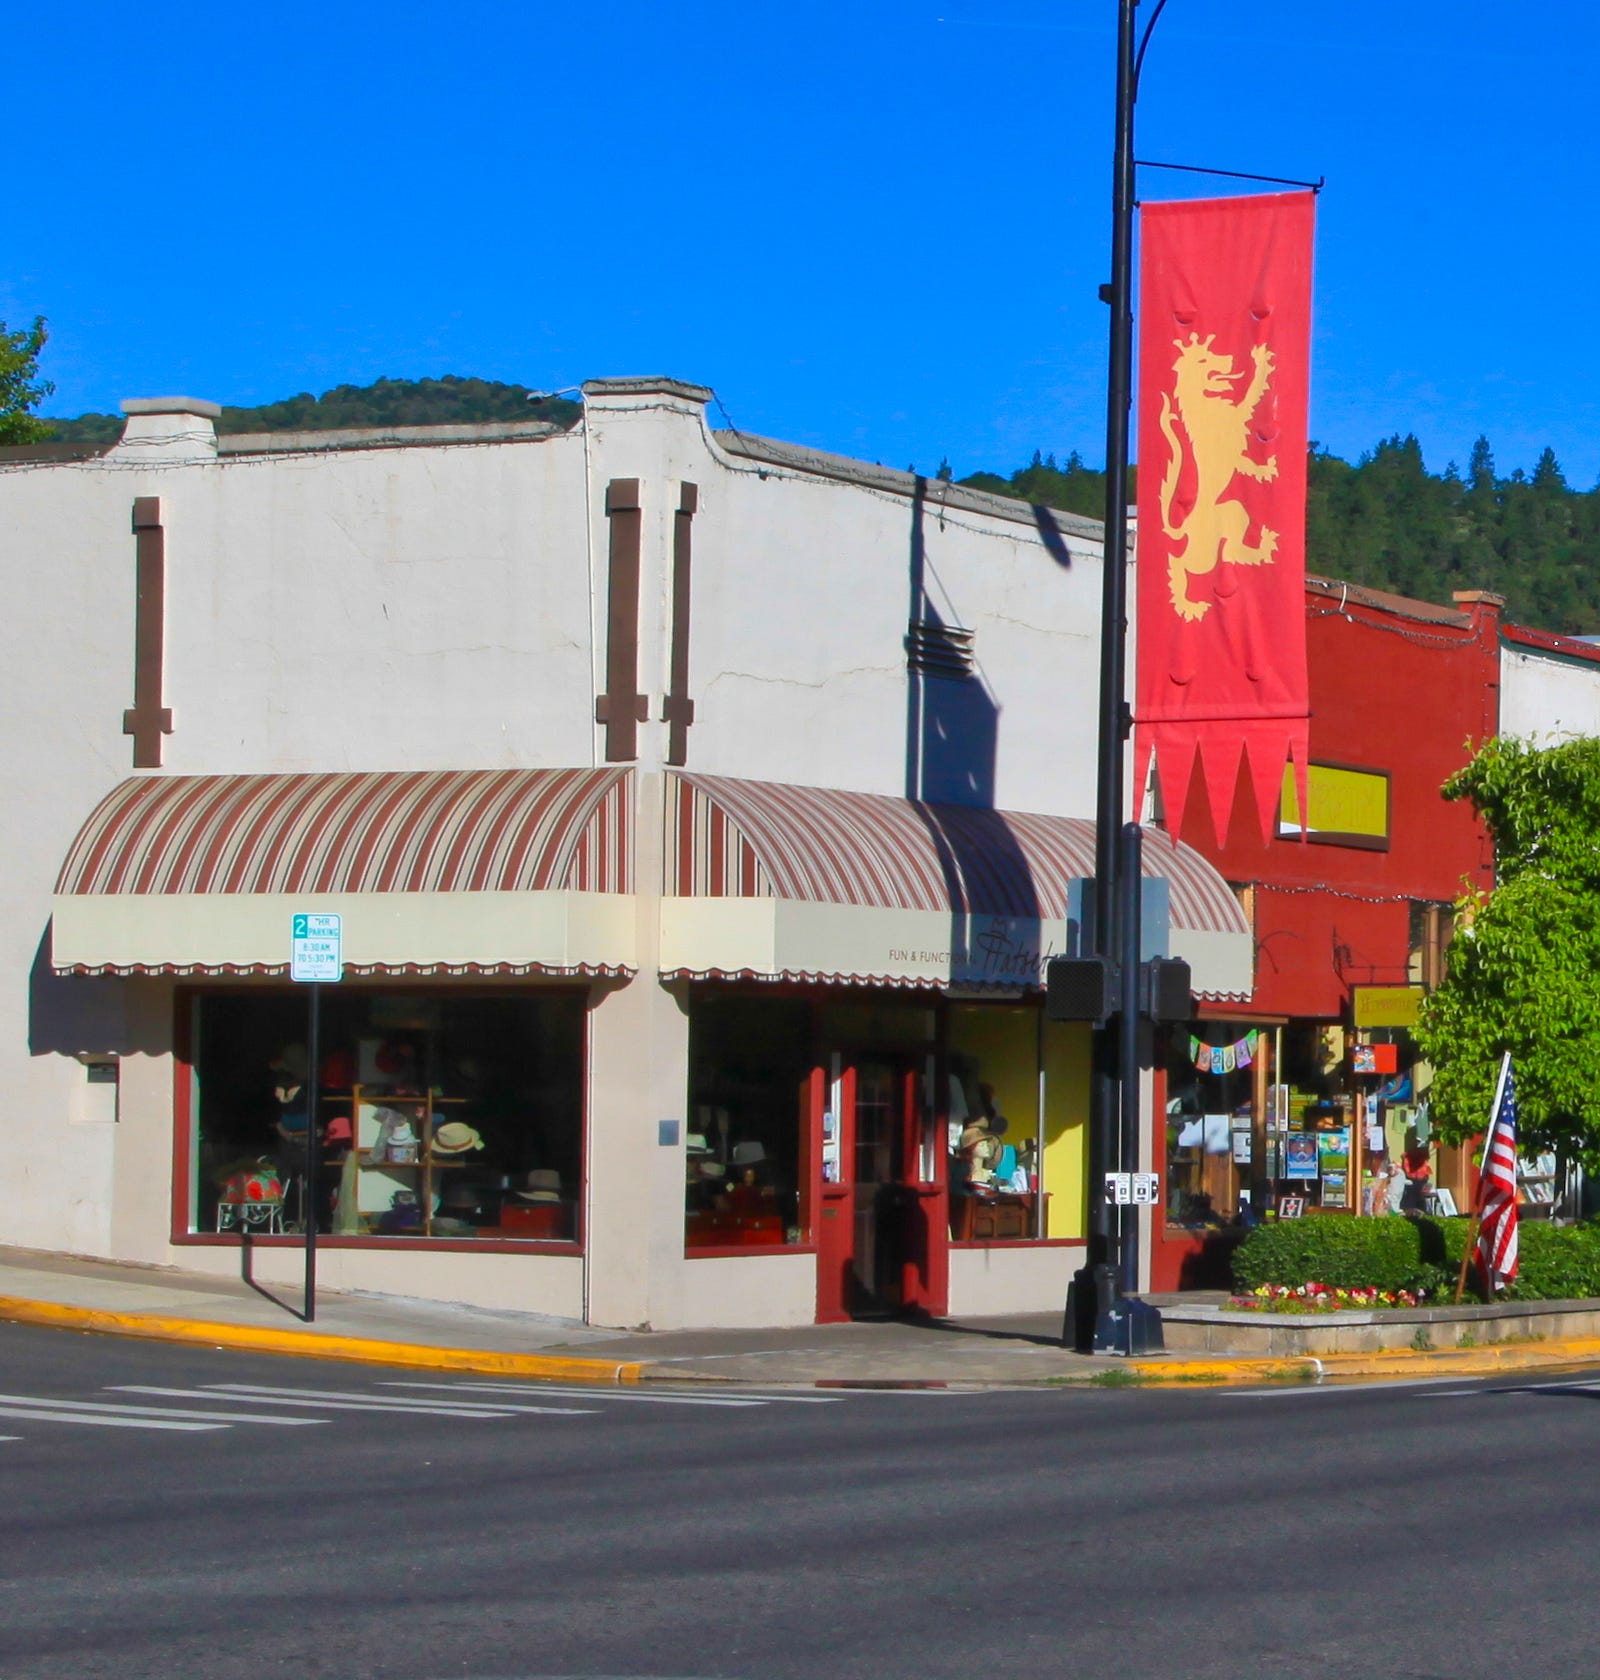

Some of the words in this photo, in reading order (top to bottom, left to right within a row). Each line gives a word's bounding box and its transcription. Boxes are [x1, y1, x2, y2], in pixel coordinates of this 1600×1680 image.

[295, 918, 306, 935] 2
[309, 928, 339, 936] PARKING
[889, 949, 908, 961] FUN
[911, 951, 917, 962] &
